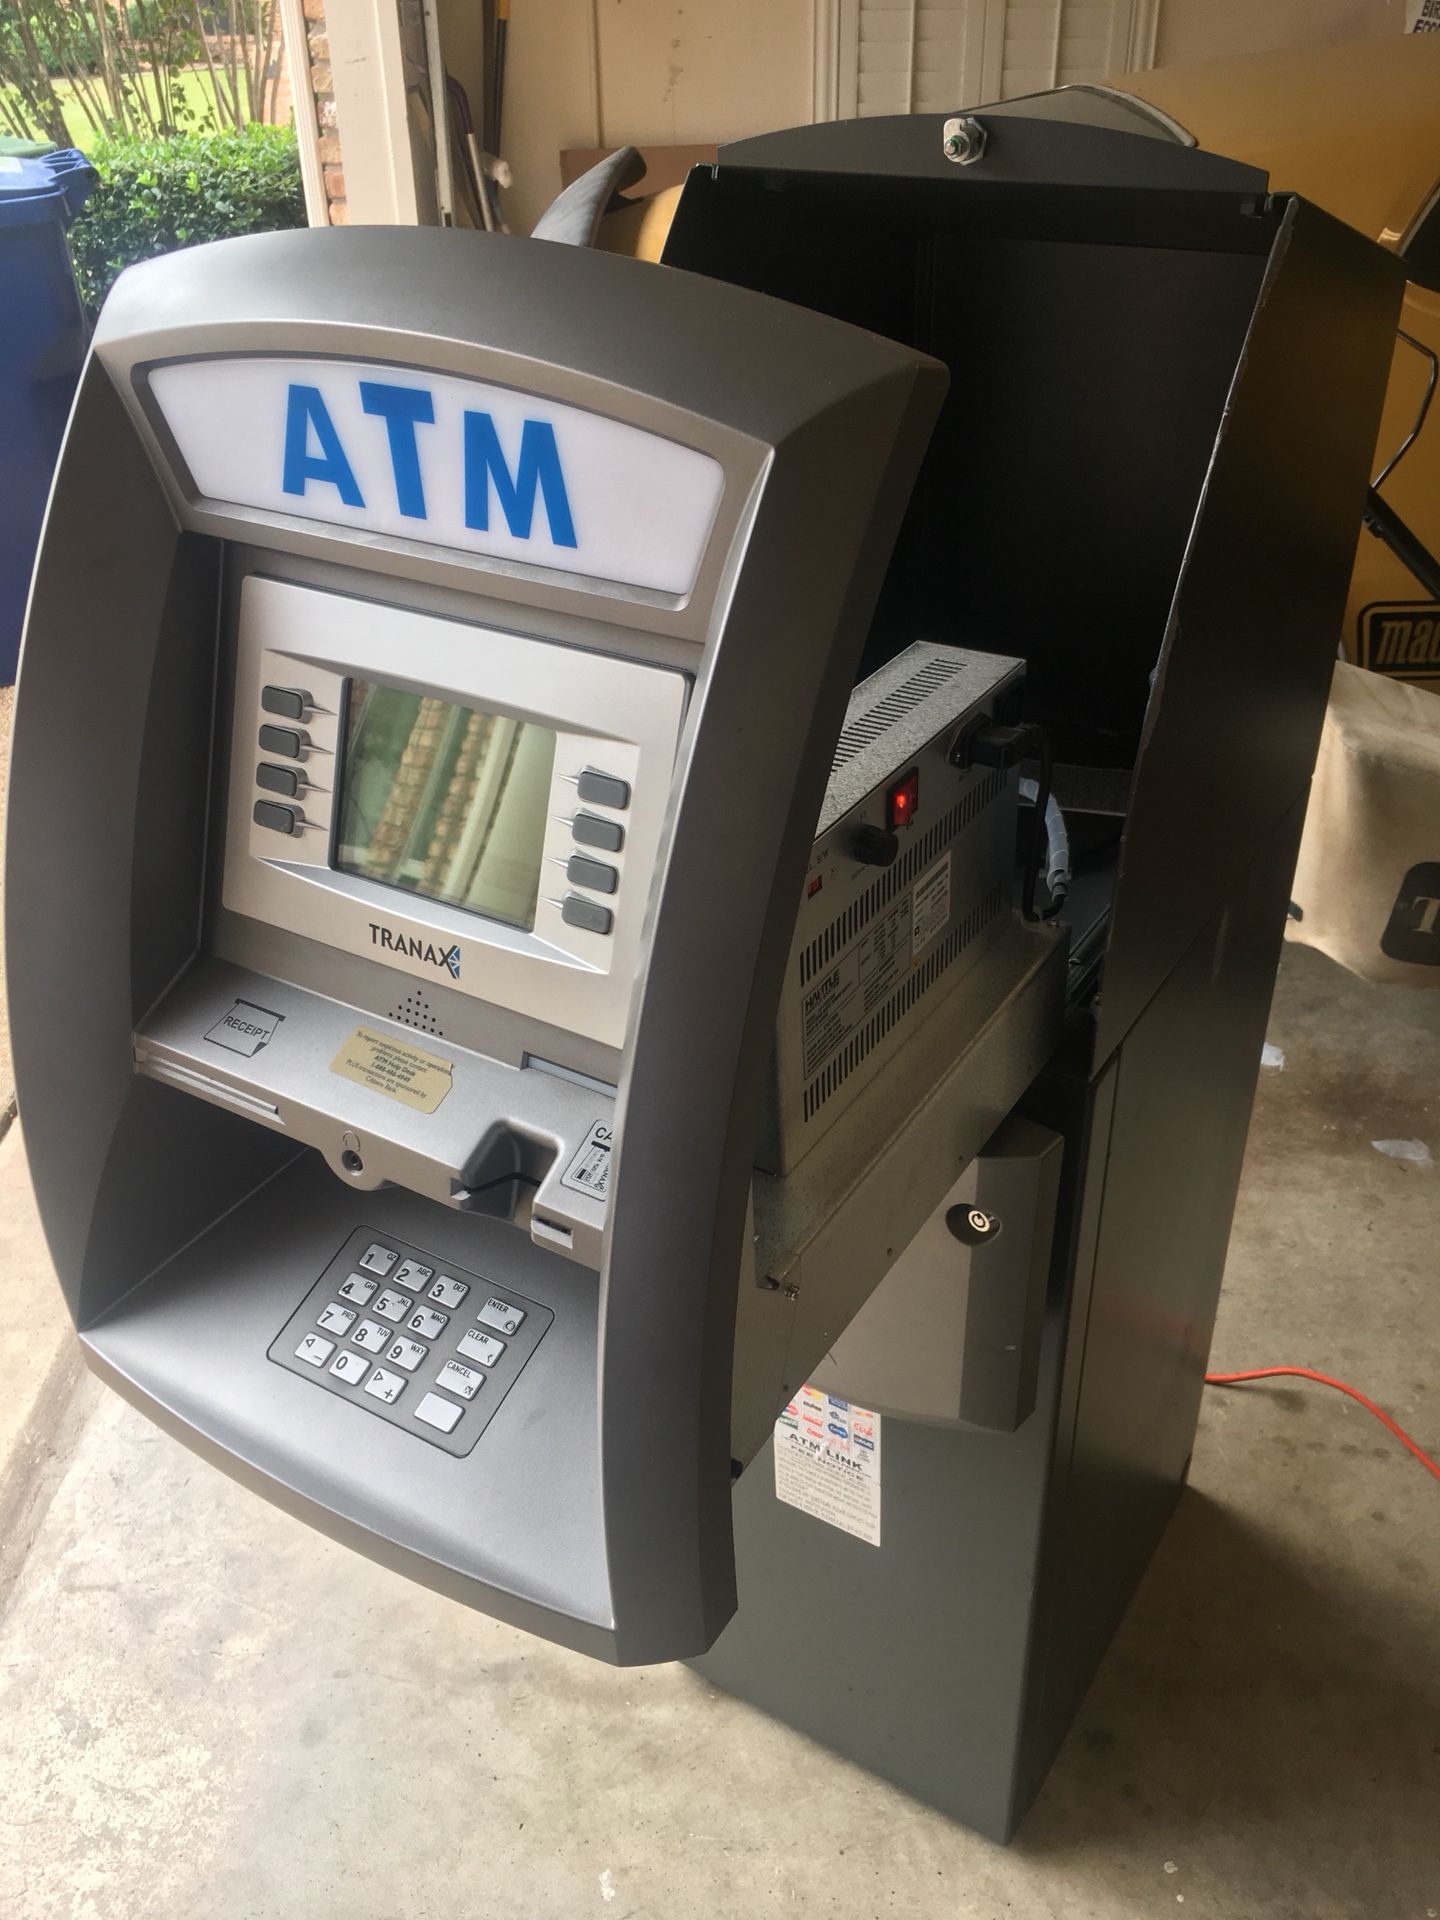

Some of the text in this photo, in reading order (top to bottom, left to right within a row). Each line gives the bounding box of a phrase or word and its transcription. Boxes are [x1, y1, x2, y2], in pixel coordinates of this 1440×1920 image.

[283, 381, 578, 549] ATM
[369, 923, 460, 980] TRANAX
[223, 1015, 270, 1040] RECEIPT
[363, 1035, 379, 1045] report
[402, 1051, 420, 1063] activity
[370, 1046, 393, 1058] problems
[392, 1054, 408, 1064] please
[374, 1055, 416, 1077] ATM Help Desk
[364, 1253, 374, 1265] 1
[396, 1268, 410, 1282] 2
[417, 1267, 431, 1277] ABC
[341, 1283, 355, 1295] 4
[364, 1282, 377, 1291] GHI
[432, 1284, 445, 1298] 3
[453, 1283, 467, 1293] DEF
[376, 1297, 389, 1311] 5
[397, 1298, 410, 1308] JKL
[487, 1300, 510, 1314] ENTER
[320, 1310, 334, 1323] 7
[341, 1310, 356, 1320] PRS
[411, 1314, 425, 1328] 6
[430, 1312, 446, 1324] MNO
[354, 1328, 368, 1342] 8
[376, 1327, 391, 1338] TUV
[467, 1330, 490, 1345] CLEAR
[390, 1345, 403, 1360] 9
[410, 1343, 426, 1356] WXY
[336, 1355, 348, 1370] 0
[446, 1361, 473, 1379] CANCEL
[789, 1434, 821, 1451] ATM
[826, 1449, 863, 1471] LINK
